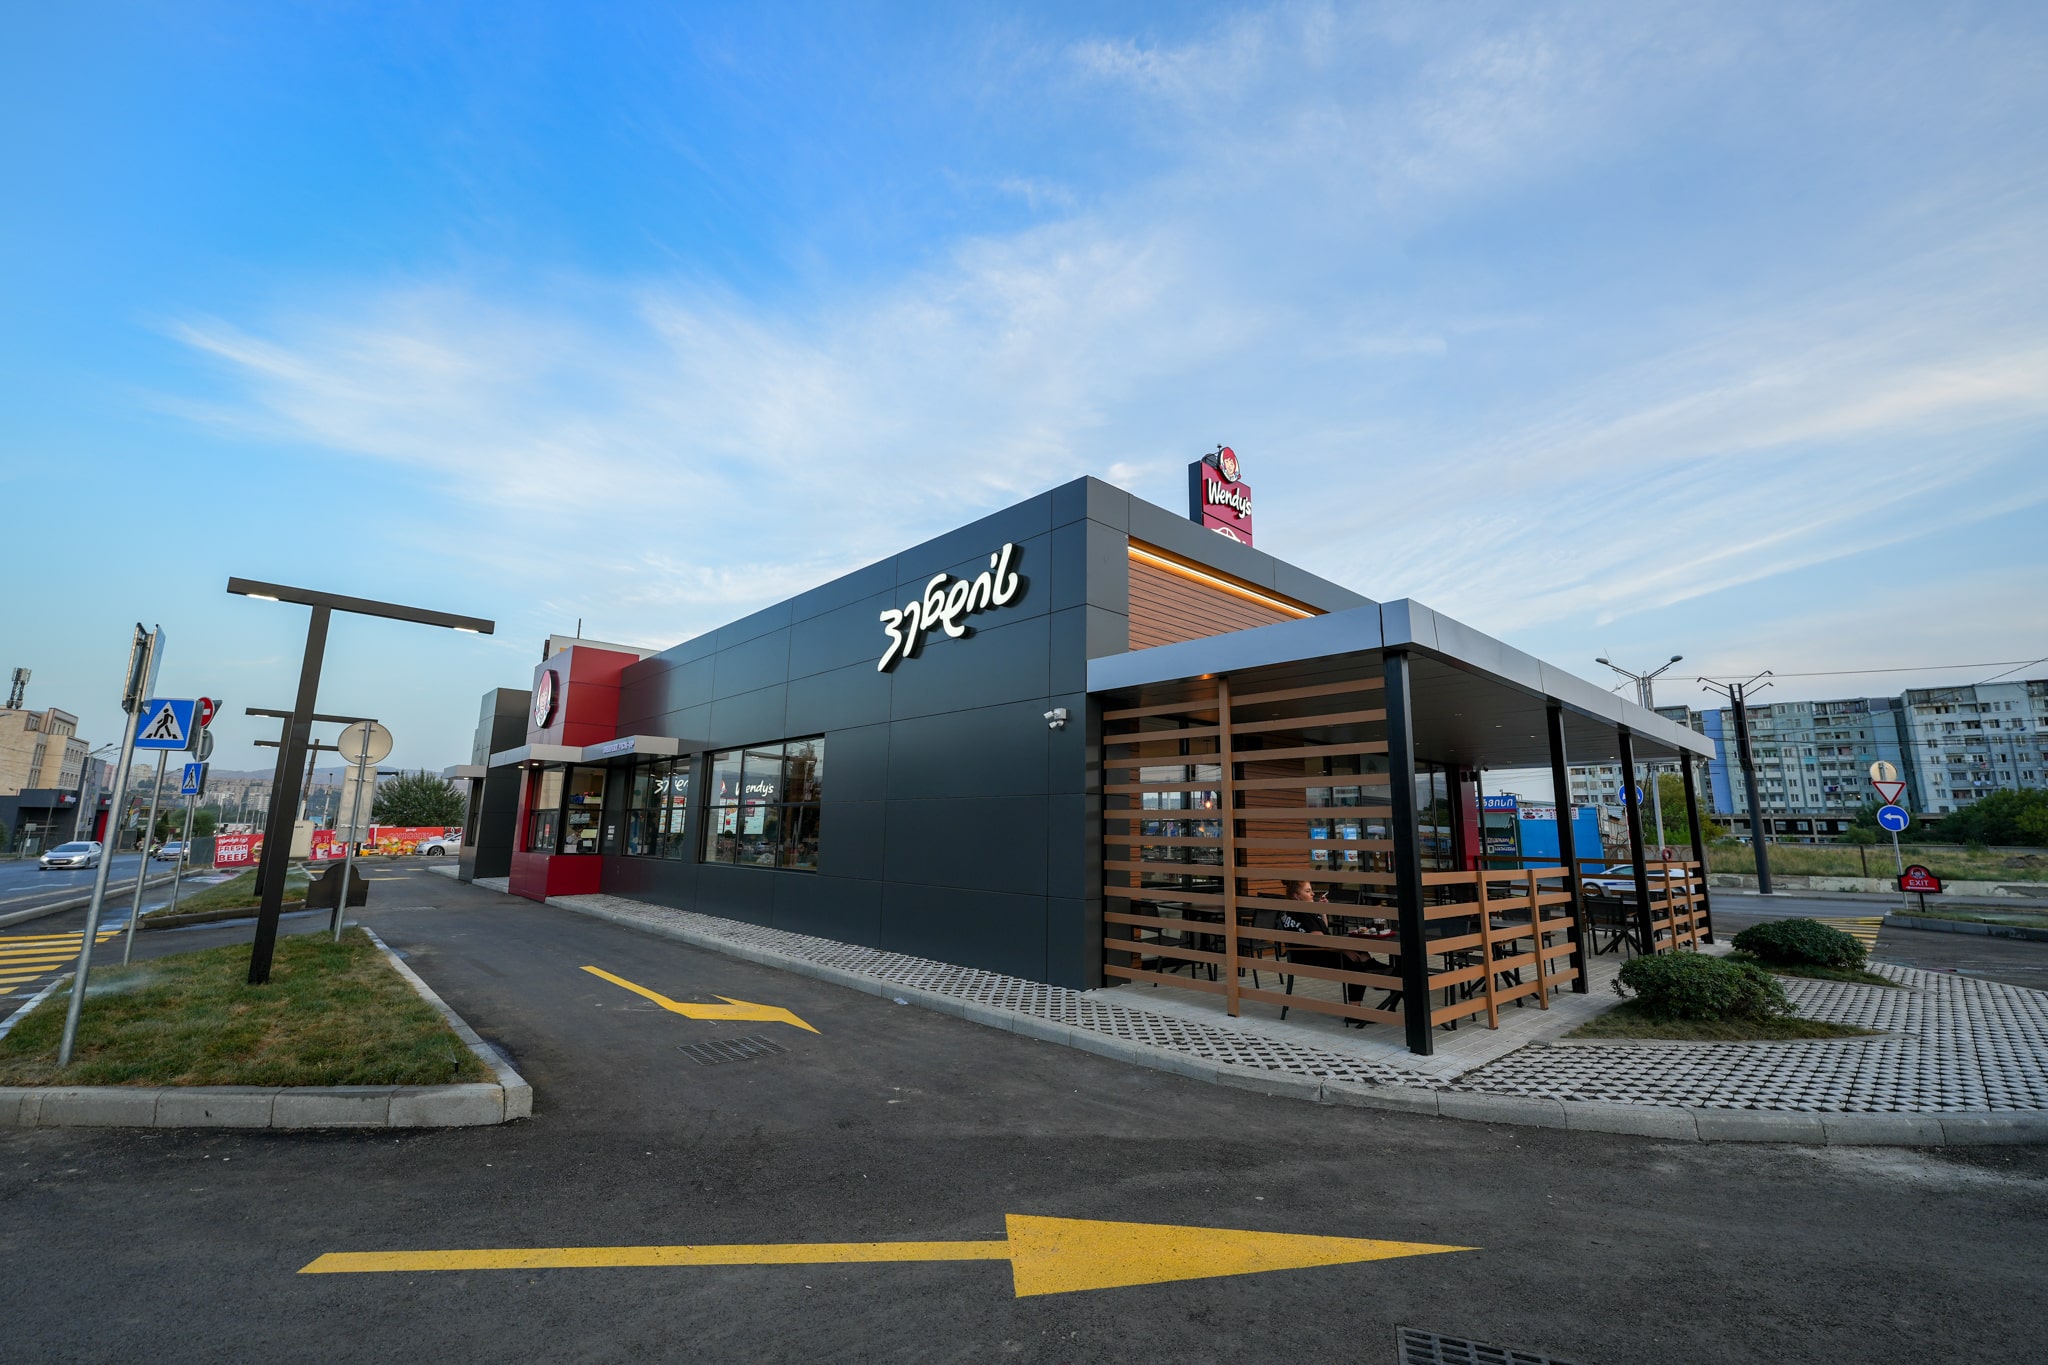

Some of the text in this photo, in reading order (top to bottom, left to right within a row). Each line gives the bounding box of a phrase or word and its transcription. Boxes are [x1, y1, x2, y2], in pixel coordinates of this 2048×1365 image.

[1208, 477, 1252, 519] Wendy's
[218, 853, 248, 862] BEEF
[1909, 879, 1929, 887] EXIT
